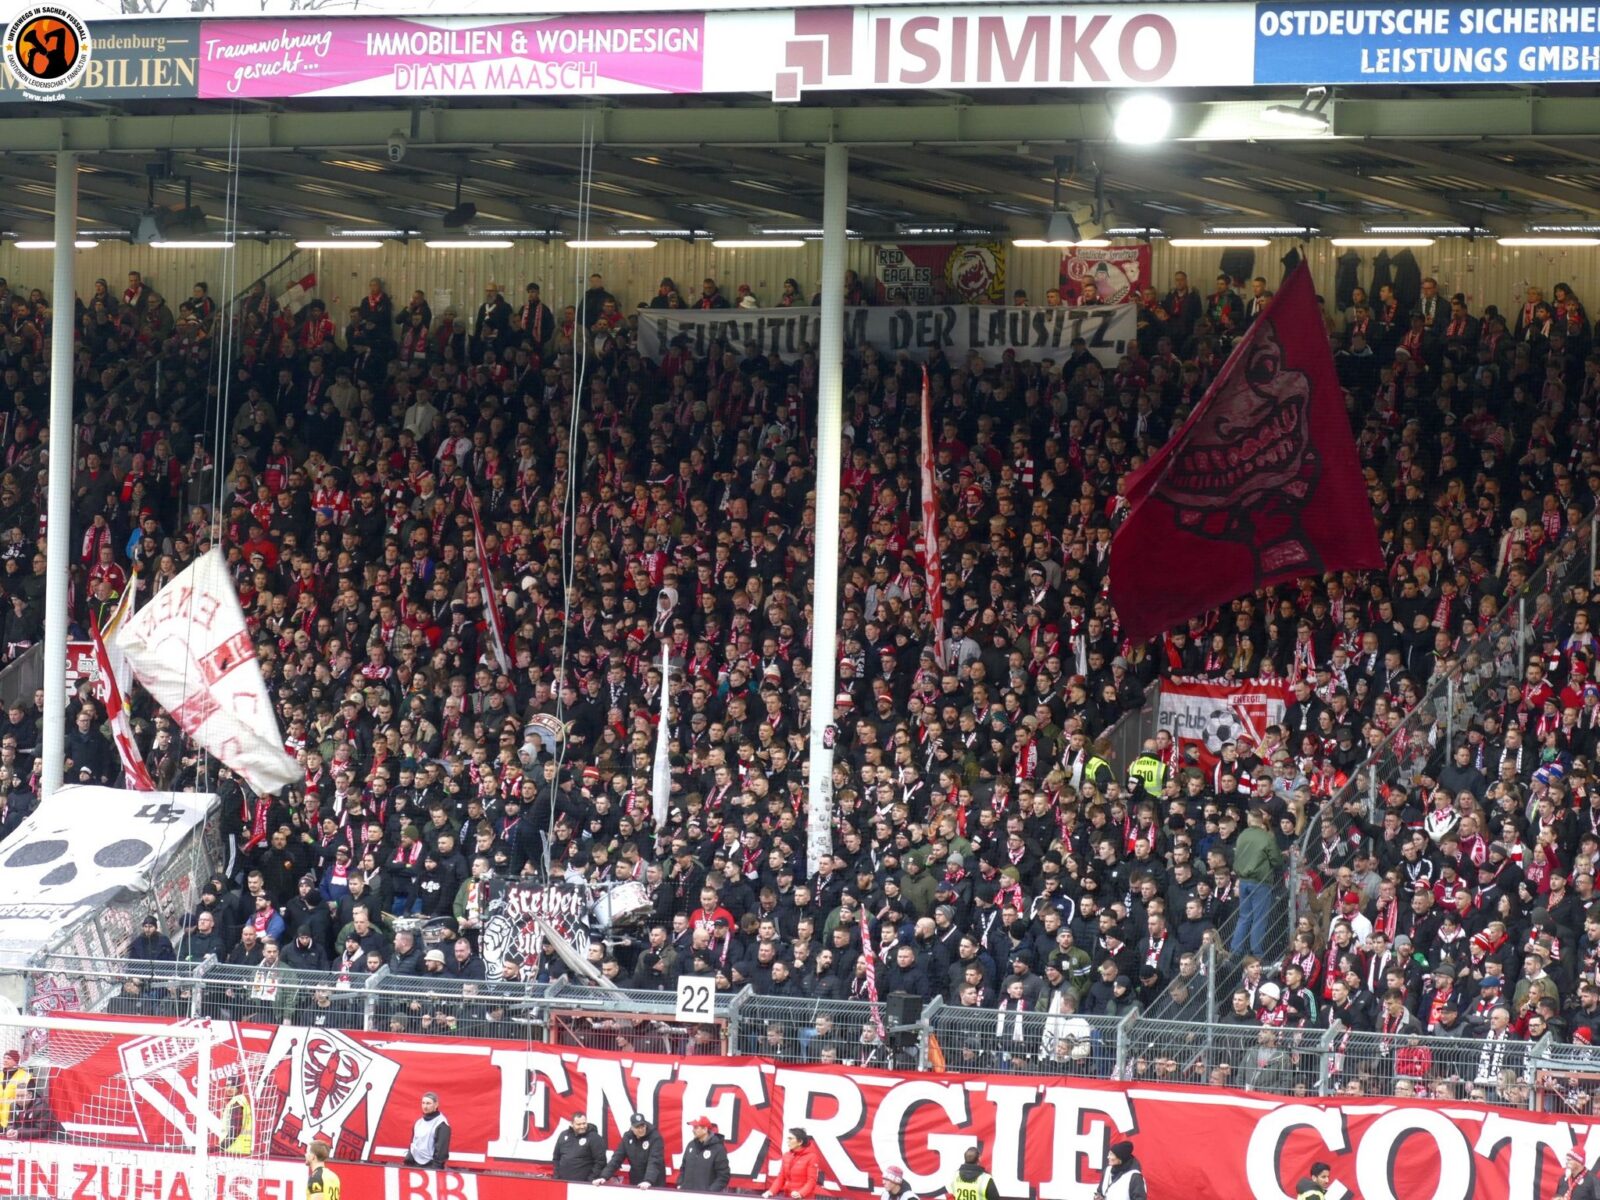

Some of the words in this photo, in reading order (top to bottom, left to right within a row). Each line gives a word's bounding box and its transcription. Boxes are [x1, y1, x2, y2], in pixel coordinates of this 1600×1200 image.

[1259, 8, 1449, 36] OSTDEUTSCHE
[1459, 6, 1600, 34] SICHERHE
[91, 34, 166, 52] andenburg
[205, 28, 332, 61] Traumwohnung
[366, 31, 503, 56] IMMOBILIEN
[511, 30, 528, 53] &
[536, 27, 699, 54] WOHNDESIGN
[874, 13, 1177, 84] ISIMKO
[1360, 47, 1508, 73] LEISTUNGS
[1518, 45, 1600, 72] GMBH
[394, 63, 476, 91] DIANA
[485, 61, 598, 90] MAASCH
[879, 250, 904, 264] RED
[883, 268, 931, 282] EAGLES
[888, 307, 957, 350] DER
[681, 985, 710, 1014] 22
[487, 1049, 1138, 1200] ENERGIE
[1246, 1103, 1600, 1200] COT
